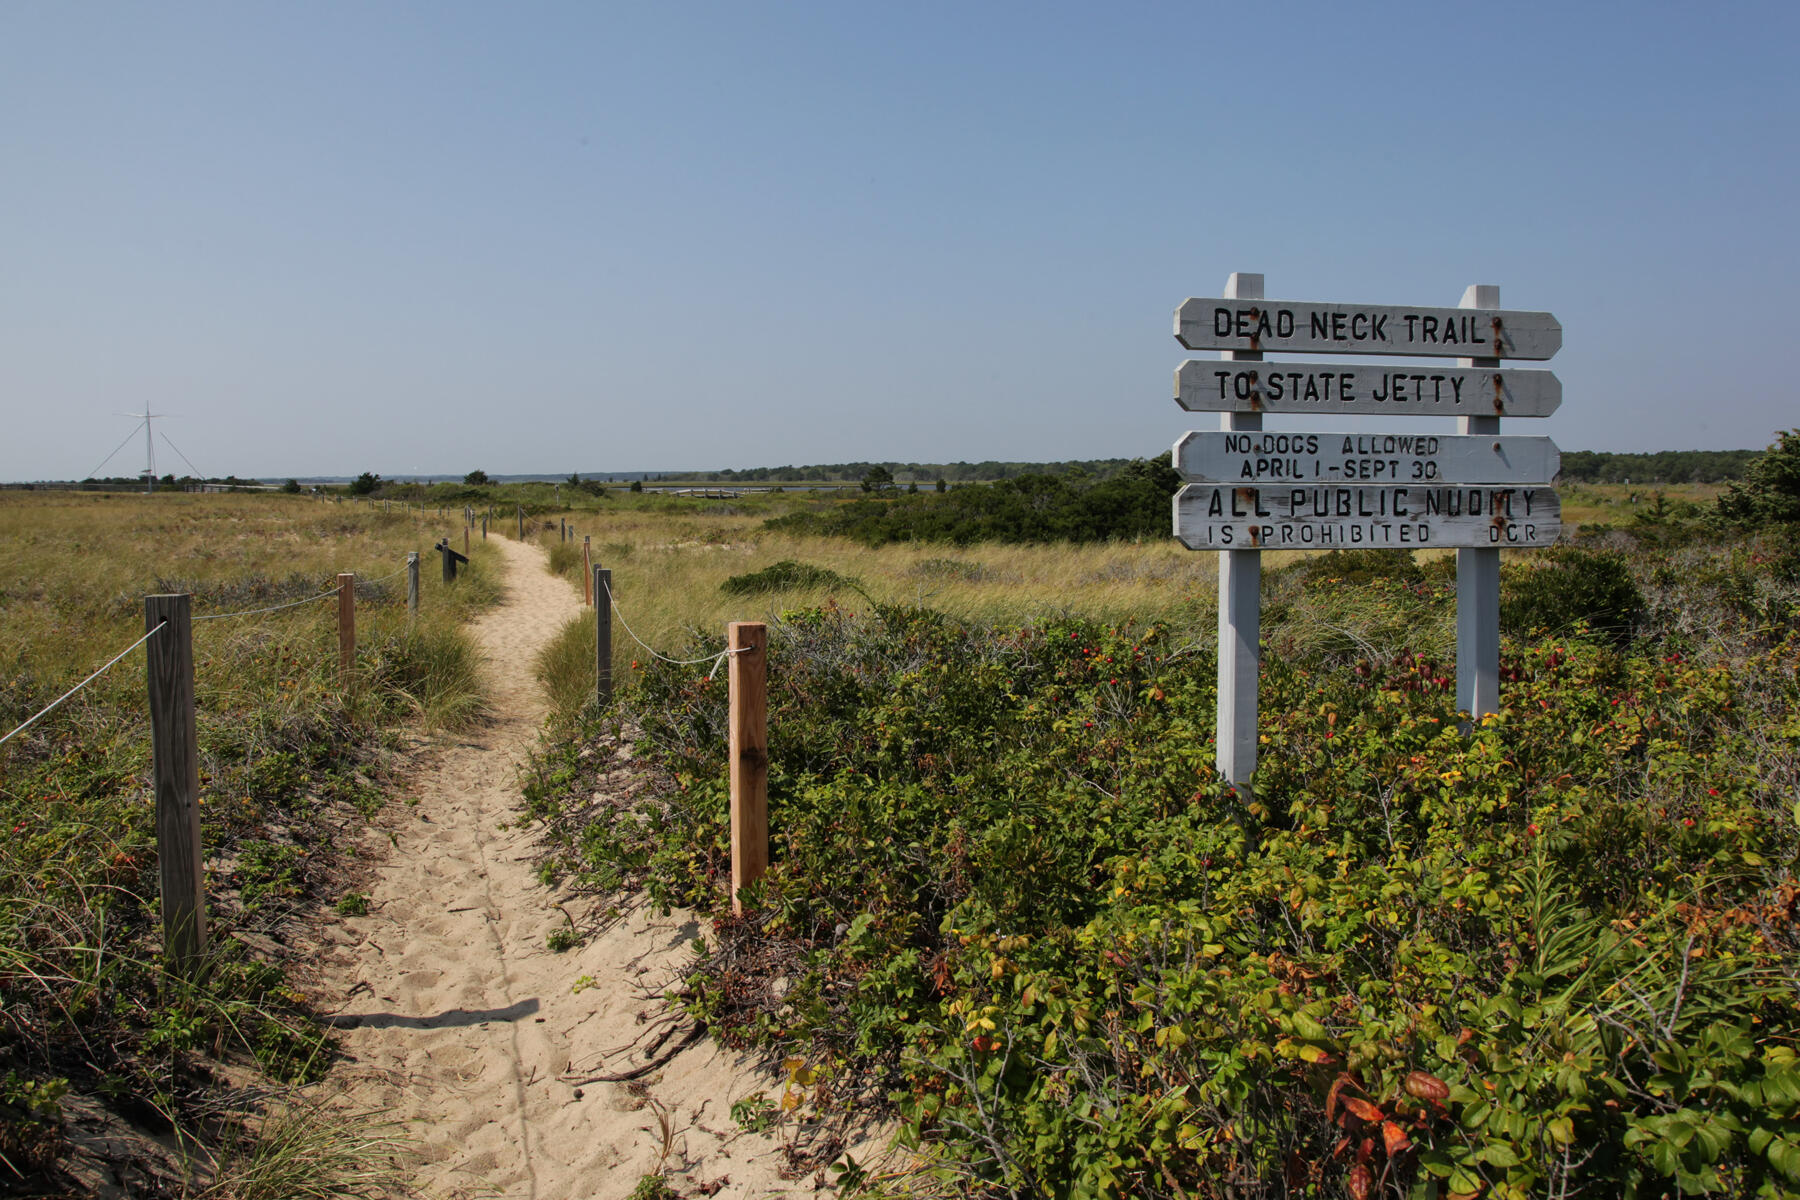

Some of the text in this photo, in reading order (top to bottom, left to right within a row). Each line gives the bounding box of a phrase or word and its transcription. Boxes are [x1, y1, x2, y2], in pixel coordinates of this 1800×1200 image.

[1214, 308, 1486, 345] DEAD NECK TRAIL
[1215, 371, 1465, 404] TO STATE JETTY
[1225, 435, 1438, 455] NO DOGS ALLOWED
[1241, 459, 1303, 479] APRIL
[1412, 461, 1437, 479] 30
[1208, 488, 1535, 517] ALL PUBLIC NUDITY
[1208, 524, 1429, 544] IS PROHIBITED
[1489, 524, 1536, 542] DCR
